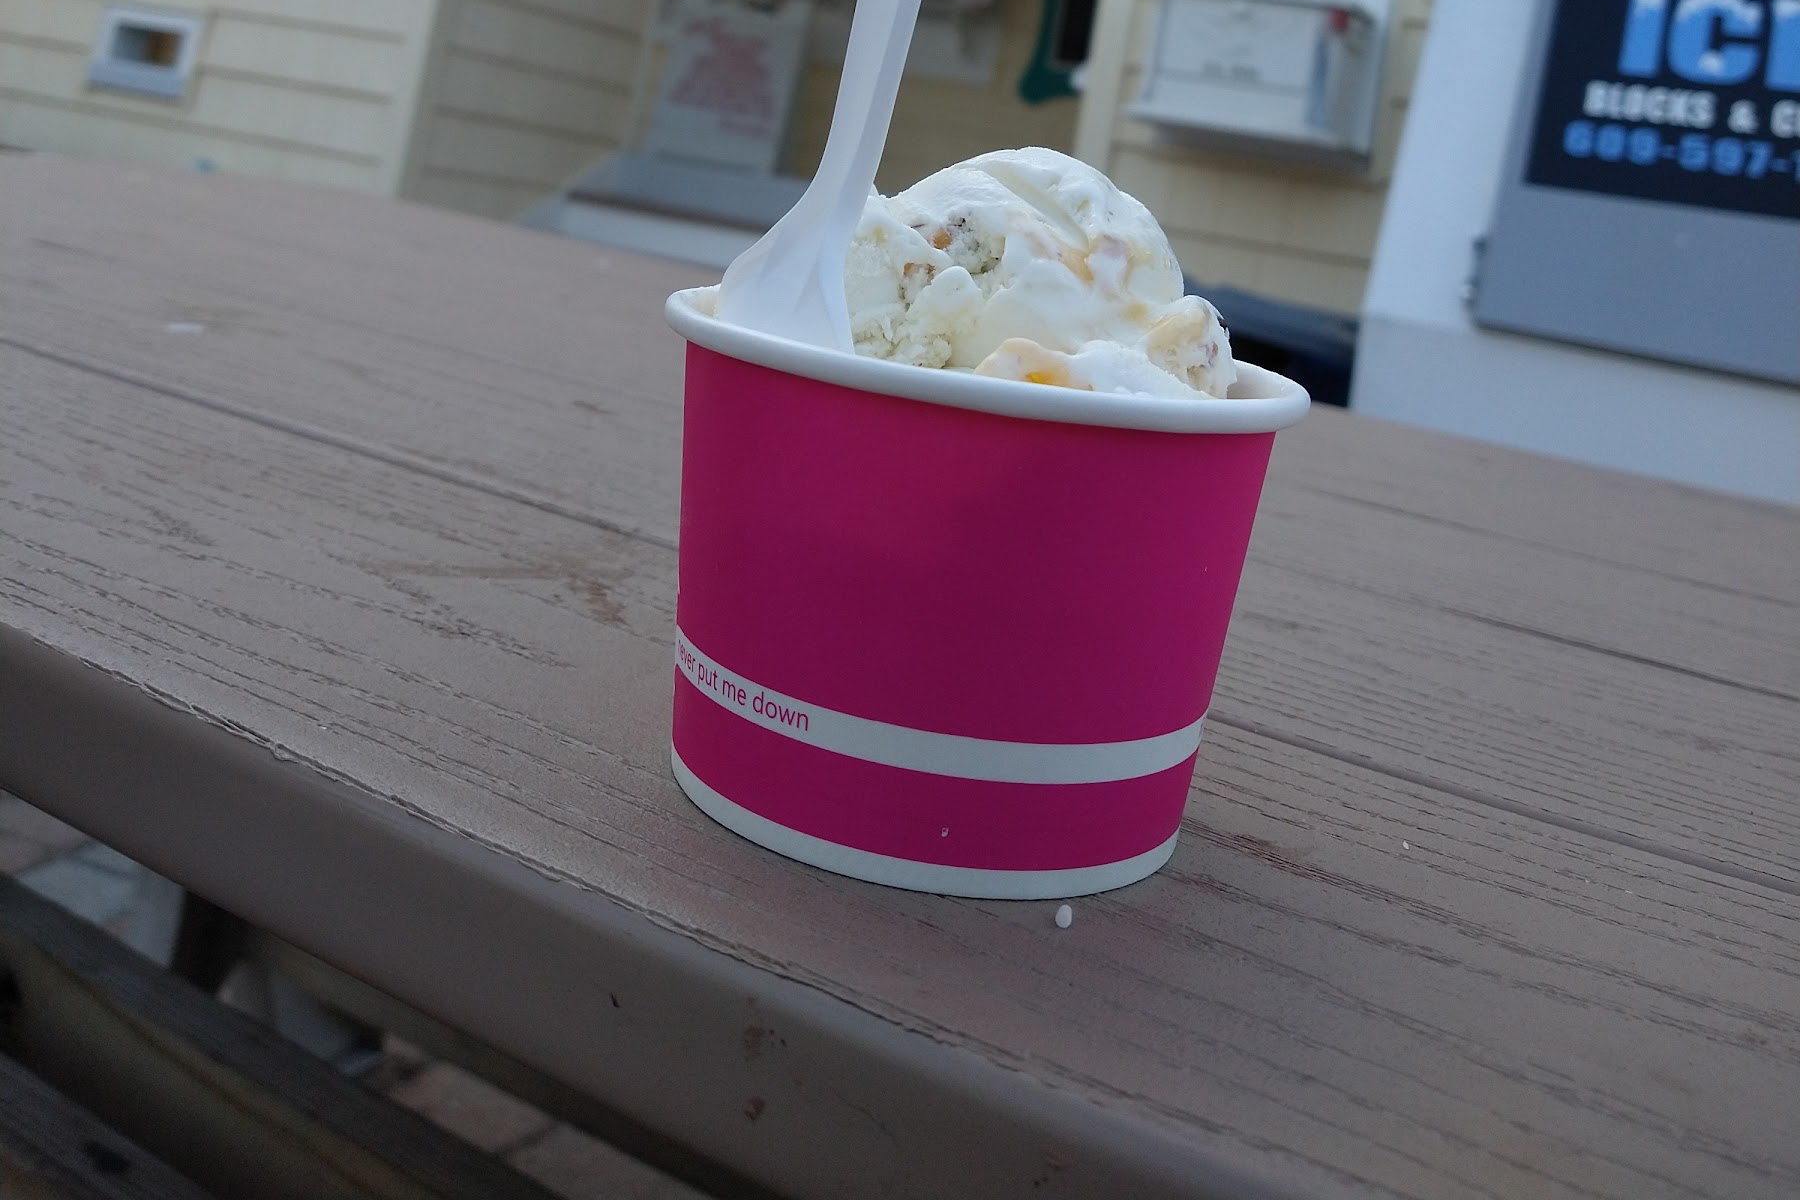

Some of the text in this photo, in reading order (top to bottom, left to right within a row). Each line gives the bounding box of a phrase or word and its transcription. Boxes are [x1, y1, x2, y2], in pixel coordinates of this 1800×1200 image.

[1581, 78, 1800, 141] BLOCKS & C
[696, 661, 719, 692] put
[721, 678, 748, 707] me
[751, 690, 810, 733] down
